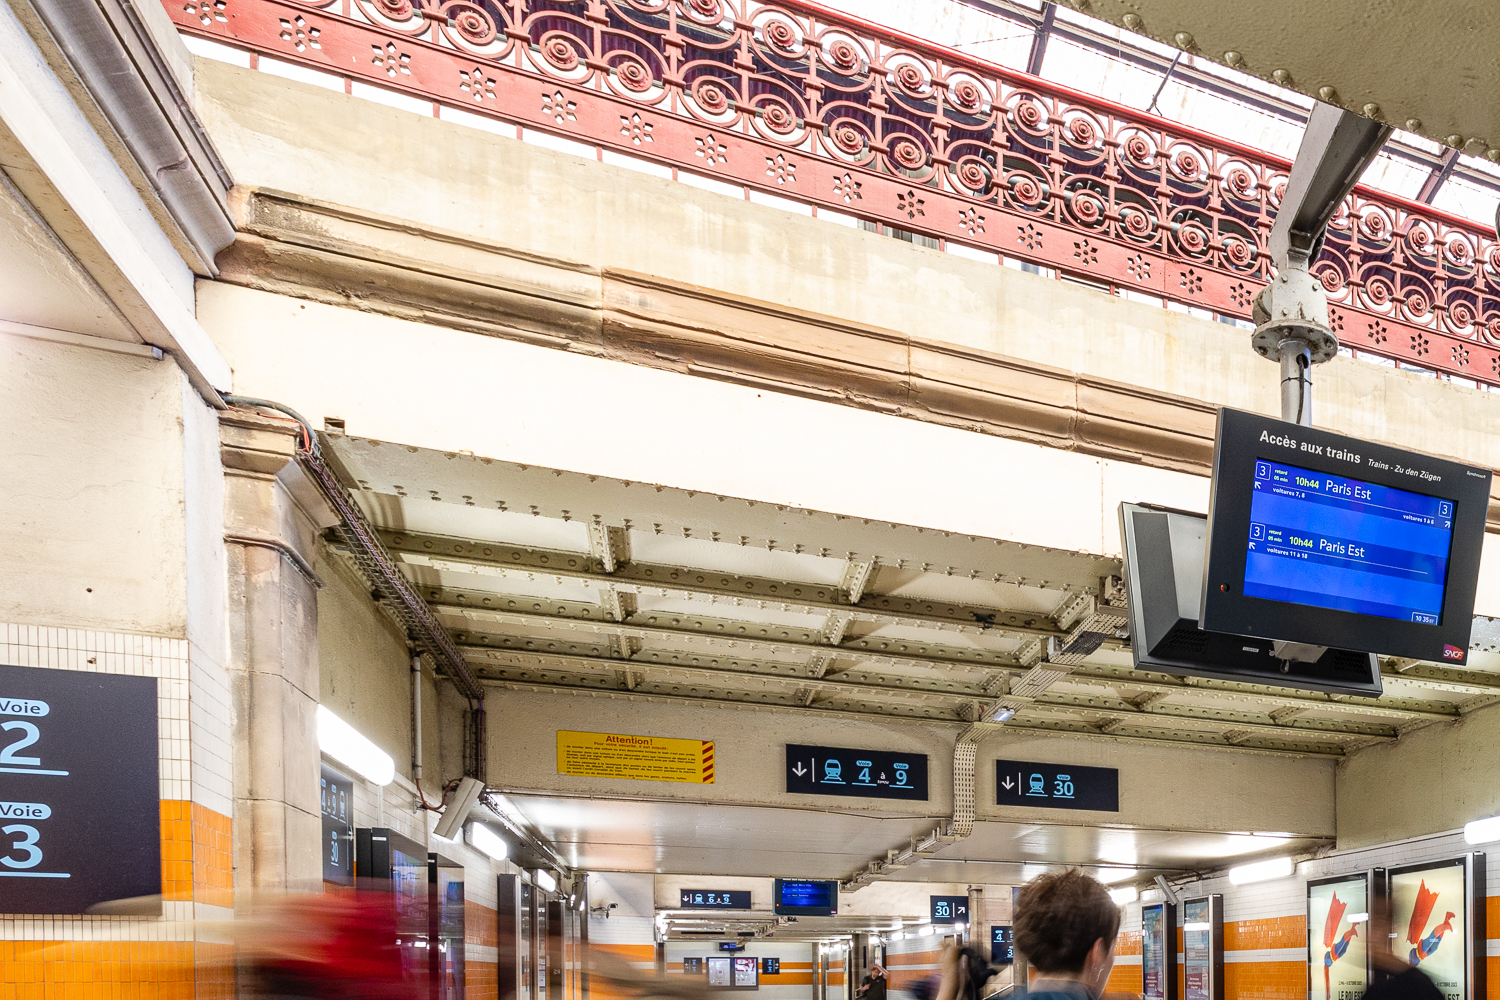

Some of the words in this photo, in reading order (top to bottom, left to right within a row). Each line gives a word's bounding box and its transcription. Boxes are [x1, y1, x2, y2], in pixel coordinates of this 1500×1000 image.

[1260, 430, 1296, 448] Accès
[1300, 442, 1323, 455] aux
[1326, 446, 1360, 464] trains
[1260, 466, 1266, 476] 3
[1368, 459, 1389, 470] Trains
[1394, 465, 1404, 474] Zu
[1406, 468, 1418, 476] den
[1420, 470, 1442, 482] Zügen
[1273, 487, 1295, 496] voitures
[1296, 476, 1320, 489] 10h44
[1326, 480, 1352, 496] Paris
[1354, 486, 1372, 500] Est
[1442, 504, 1448, 514] 3
[1403, 514, 1422, 522] voitures
[1254, 526, 1260, 536] 3
[1267, 548, 1288, 556] voitures
[1290, 536, 1313, 548] 10h44
[1320, 539, 1345, 554] Paris
[1348, 544, 1365, 558] Est
[1444, 650, 1462, 658] SNCF
[0, 701, 41, 714] Voie
[0, 720, 41, 766] 2
[858, 768, 871, 783] 4
[880, 772, 886, 780] à
[896, 770, 908, 786] 9
[1054, 780, 1074, 796] 30
[0, 804, 43, 818] Voie
[0, 824, 44, 869] 3
[936, 906, 950, 916] 30
[1338, 990, 1344, 1000] LE
